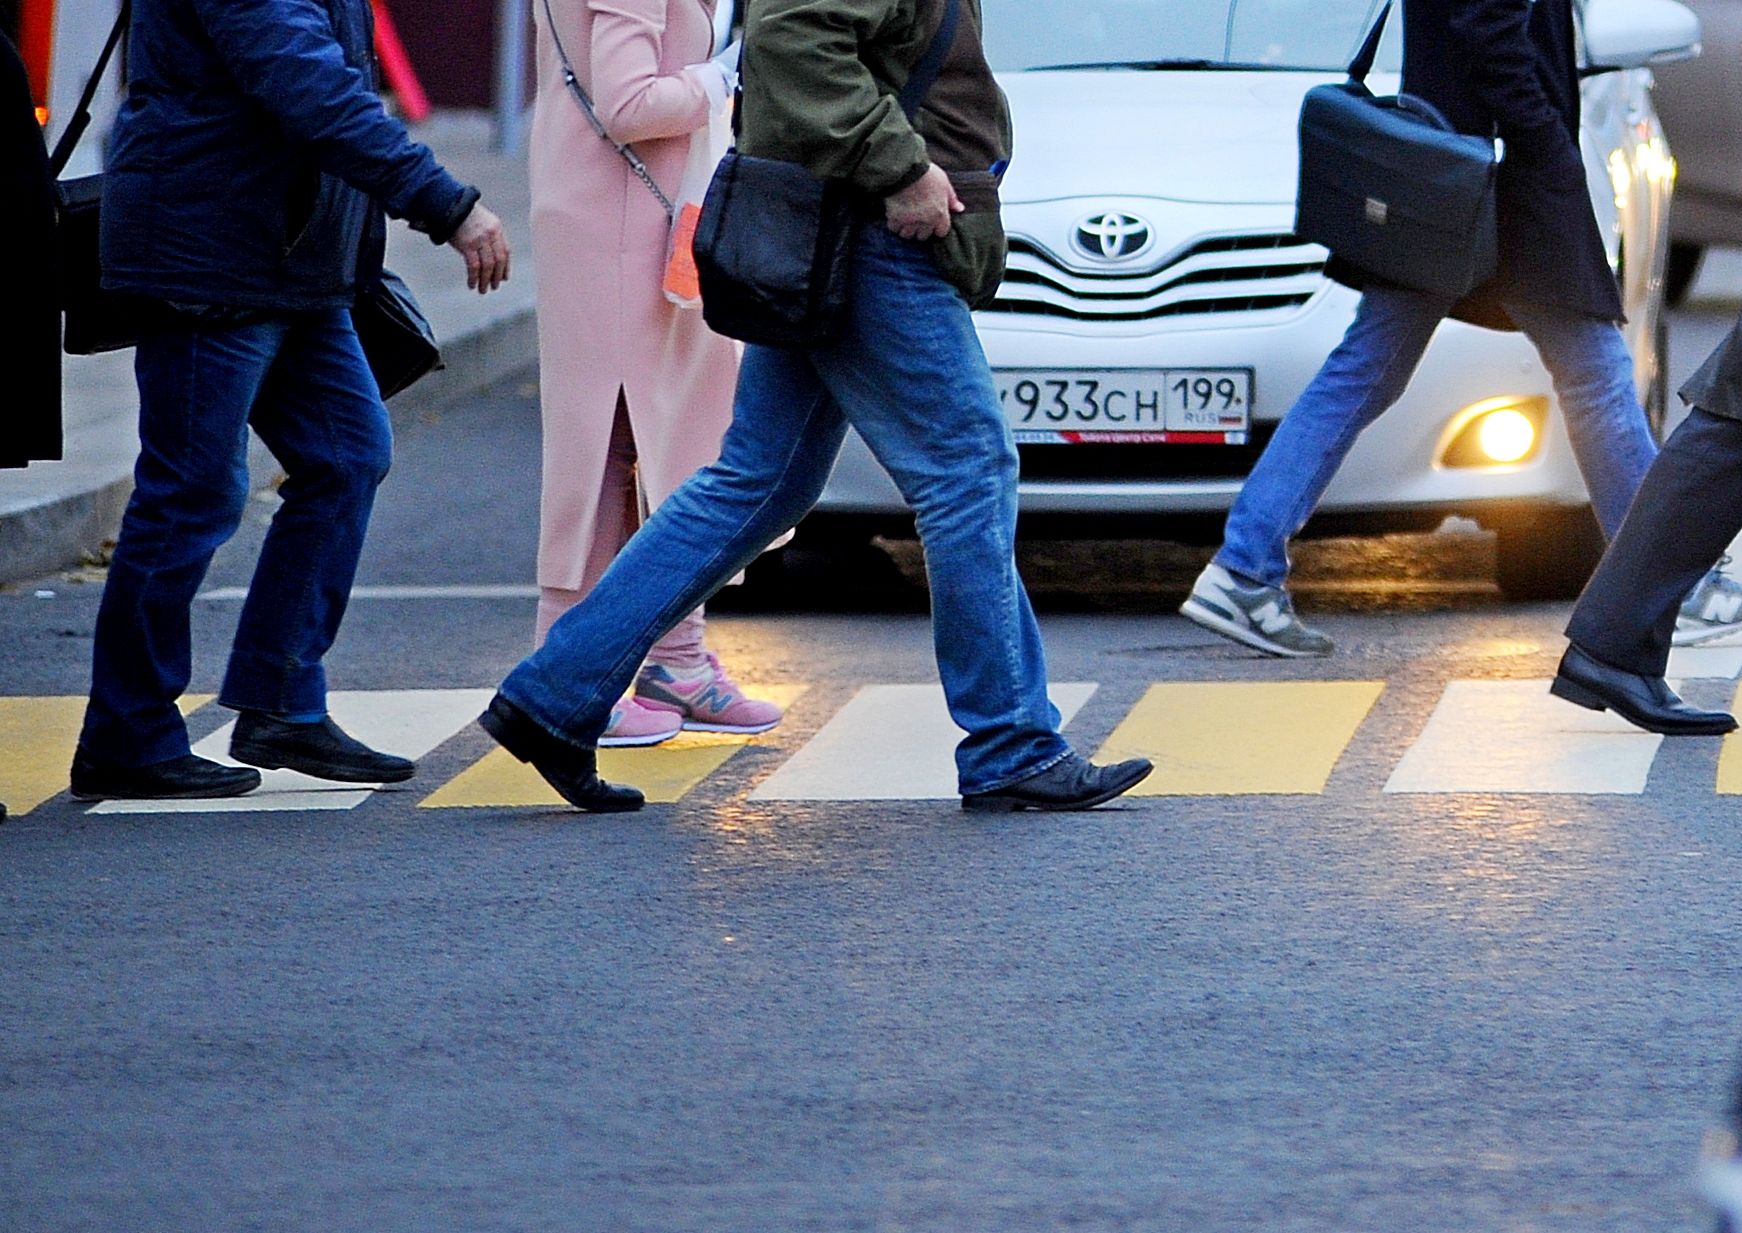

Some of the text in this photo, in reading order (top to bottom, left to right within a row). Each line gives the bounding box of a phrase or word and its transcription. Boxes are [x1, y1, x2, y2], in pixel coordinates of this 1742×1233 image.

[1172, 377, 1238, 410] 199
[1184, 411, 1217, 424] RUS
[1250, 599, 1293, 635] N
[1702, 591, 1742, 624] N
[696, 685, 733, 714] N
